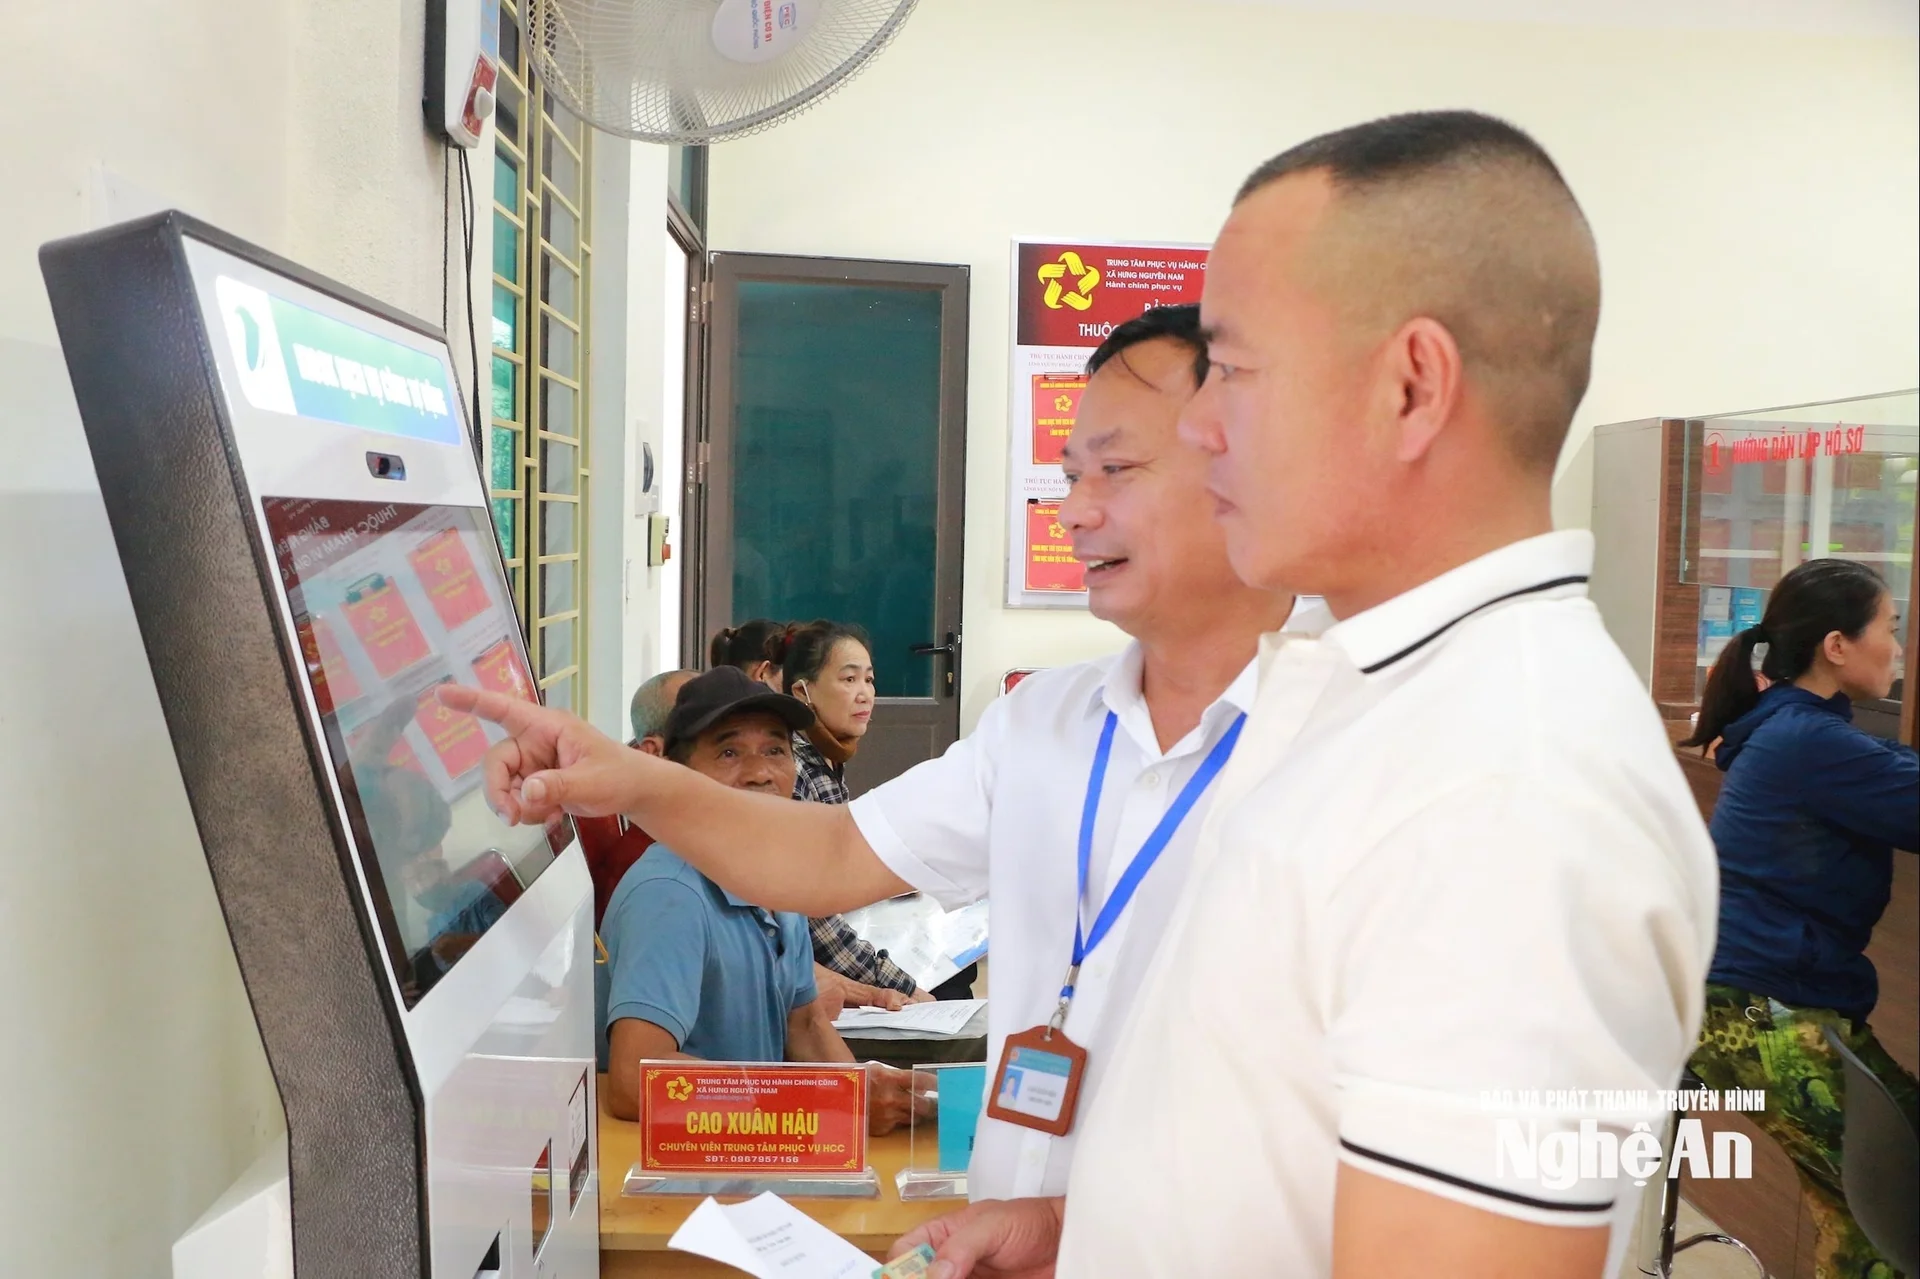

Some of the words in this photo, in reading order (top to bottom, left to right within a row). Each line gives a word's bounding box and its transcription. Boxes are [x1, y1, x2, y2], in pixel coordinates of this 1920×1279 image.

[1106, 259, 1129, 267] TRUNG
[1130, 259, 1145, 268] TÂM
[1147, 261, 1166, 269] PHỤC
[1167, 262, 1177, 270] VỤ
[1178, 261, 1199, 269] HÀNH
[1106, 270, 1116, 278] XÃ
[1139, 271, 1166, 280] NGUYÊN
[1151, 283, 1171, 291] phục
[1846, 425, 1864, 453] SƠ
[740, 1079, 759, 1087] PHỤC
[794, 1078, 817, 1086] CHÍNH
[730, 1086, 759, 1094] NGUYÊN
[686, 1111, 723, 1134] CAO
[727, 1108, 777, 1135] XUÂN
[782, 1108, 819, 1140] HẬU
[659, 1141, 698, 1151] CHUYÊN
[699, 1141, 721, 1152] VIÊN
[723, 1143, 754, 1152] TRUNG
[756, 1142, 777, 1153] TÂM
[779, 1144, 806, 1155] PHỤC
[808, 1144, 821, 1155] VỤ
[823, 1144, 845, 1153] HCC
[705, 1155, 728, 1163] SĐT:
